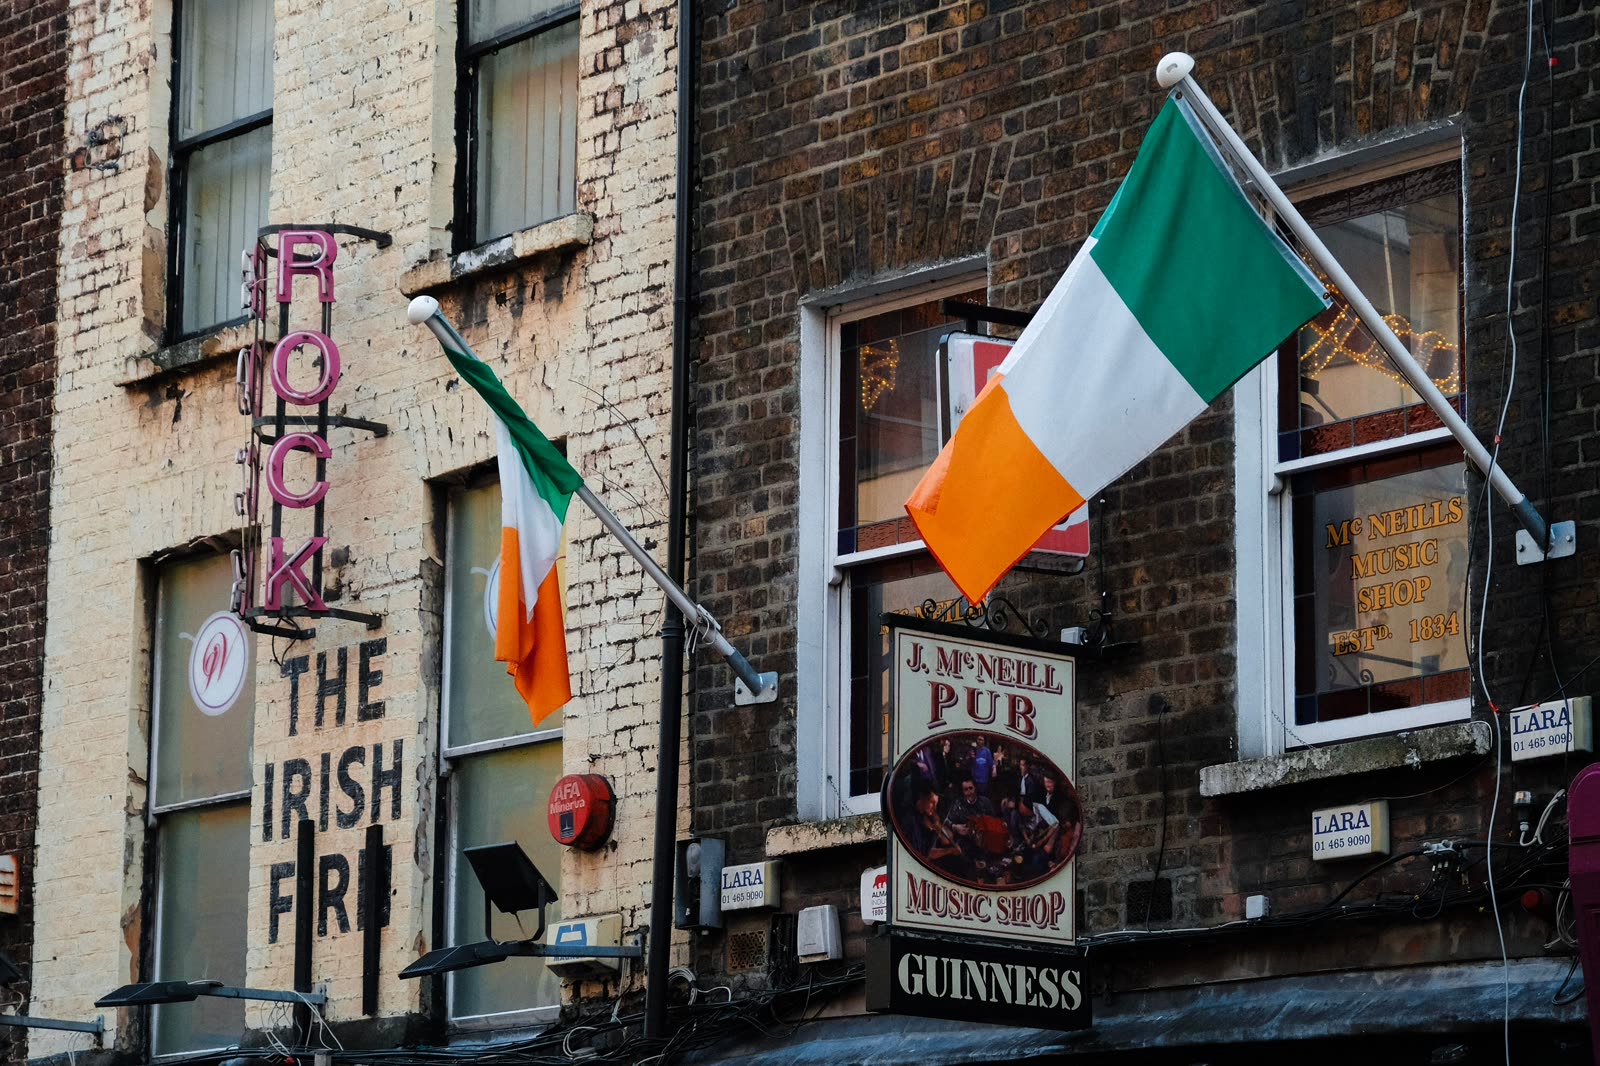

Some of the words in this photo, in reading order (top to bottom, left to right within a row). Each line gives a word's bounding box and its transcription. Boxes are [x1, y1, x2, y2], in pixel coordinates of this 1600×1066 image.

[264, 230, 340, 611] ROCK
[1368, 497, 1464, 540] NEILLS
[1350, 538, 1439, 580] MUSIC
[1358, 575, 1431, 613] SHOP
[1409, 611, 1459, 643] 1834
[906, 642, 930, 674] J.
[281, 637, 387, 736] THE
[927, 681, 1038, 740] PUB
[1512, 707, 1572, 735] LARA
[1513, 741, 1524, 752] 01
[1528, 737, 1546, 748] 465
[1548, 732, 1573, 745] 9090
[263, 739, 403, 842] IRISH
[550, 798, 586, 815] Minerva
[554, 782, 580, 802] AFA
[1314, 810, 1370, 835] LARA
[1314, 841, 1325, 851] 01
[1328, 838, 1345, 849] 465
[1347, 834, 1370, 846] 9090
[722, 869, 763, 890] LARA
[722, 895, 730, 904] 01
[732, 892, 745, 903] 465
[746, 890, 763, 901] 9090
[905, 870, 991, 923] MUSIC
[996, 891, 1066, 930] SHOP
[898, 953, 1081, 1011] GUINNESS
